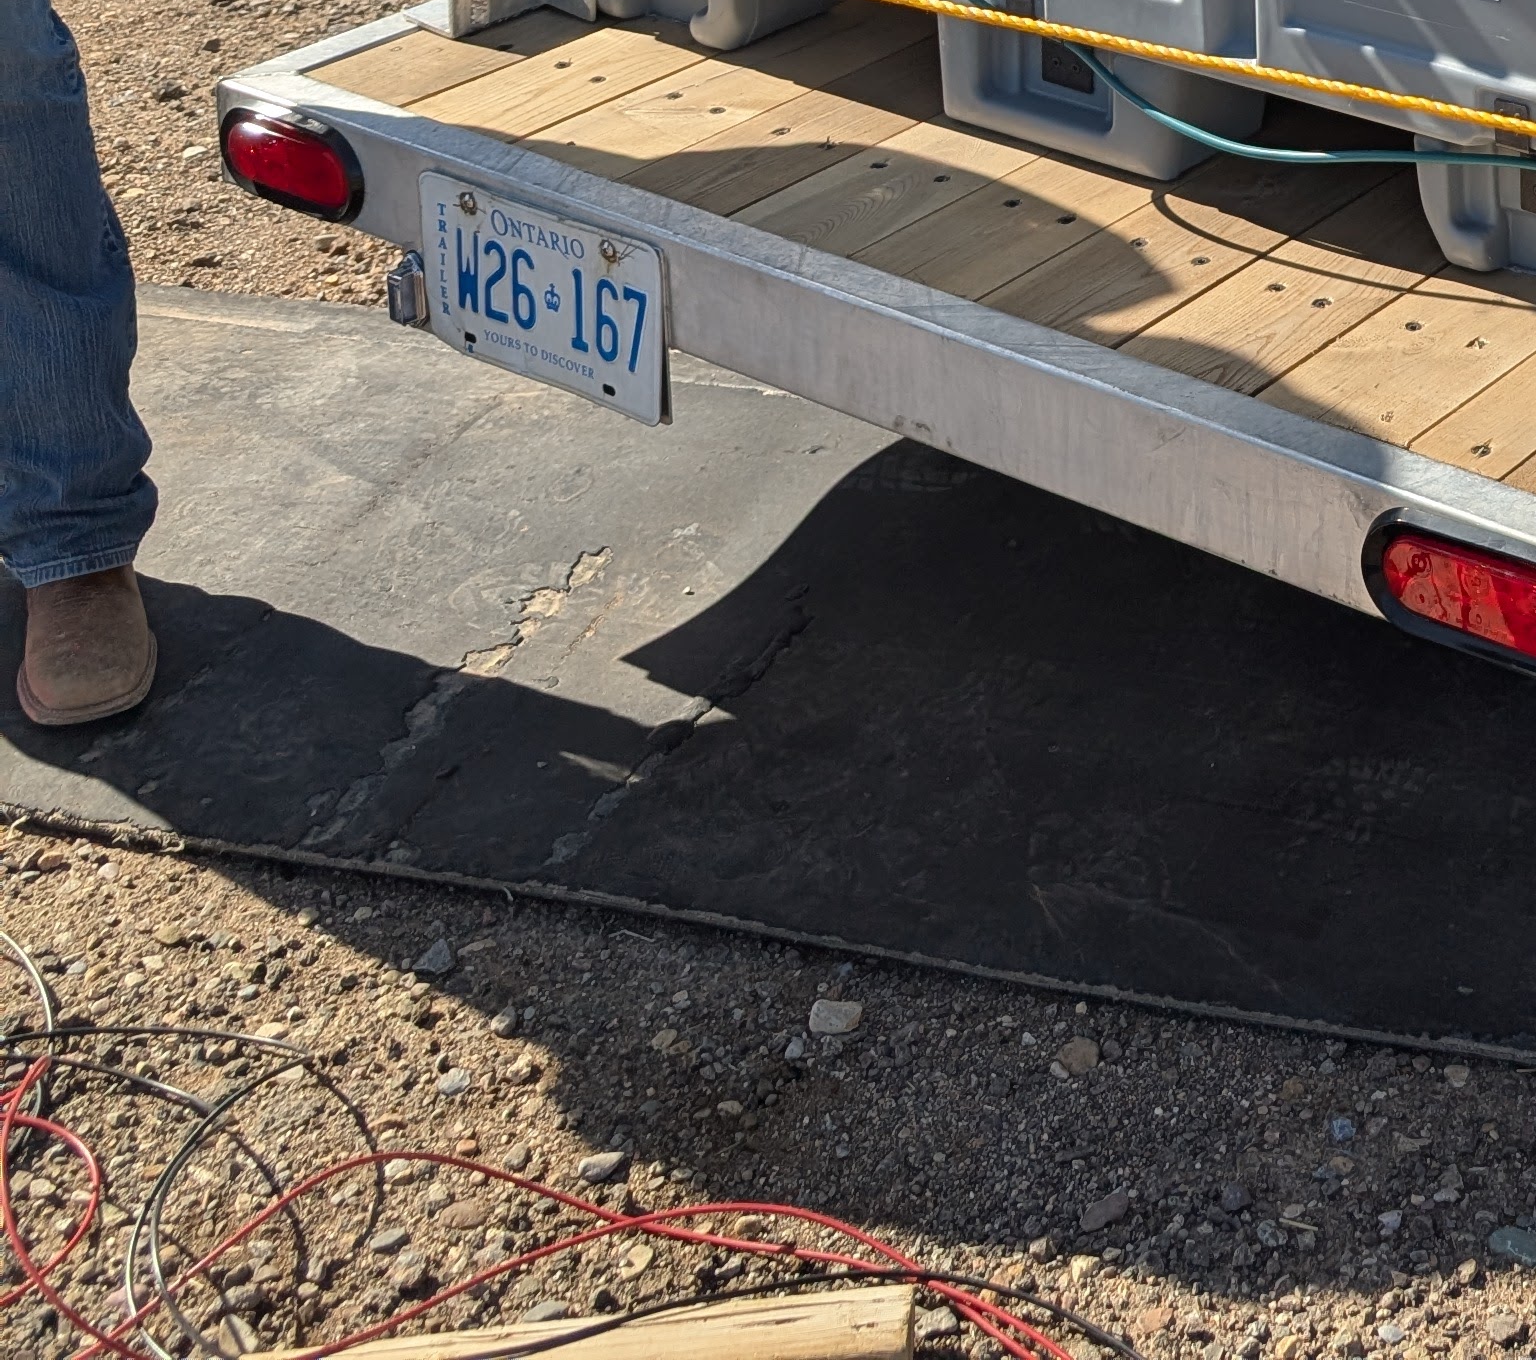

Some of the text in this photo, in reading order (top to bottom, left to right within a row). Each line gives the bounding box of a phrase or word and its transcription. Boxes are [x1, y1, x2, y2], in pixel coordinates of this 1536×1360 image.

[436, 202, 451, 316] TRAILER
[490, 209, 585, 260] ONTARIO
[456, 227, 648, 373] W26 167
[484, 329, 522, 351] YOURS
[523, 341, 538, 357] TO
[540, 347, 595, 380] DISCOVER
